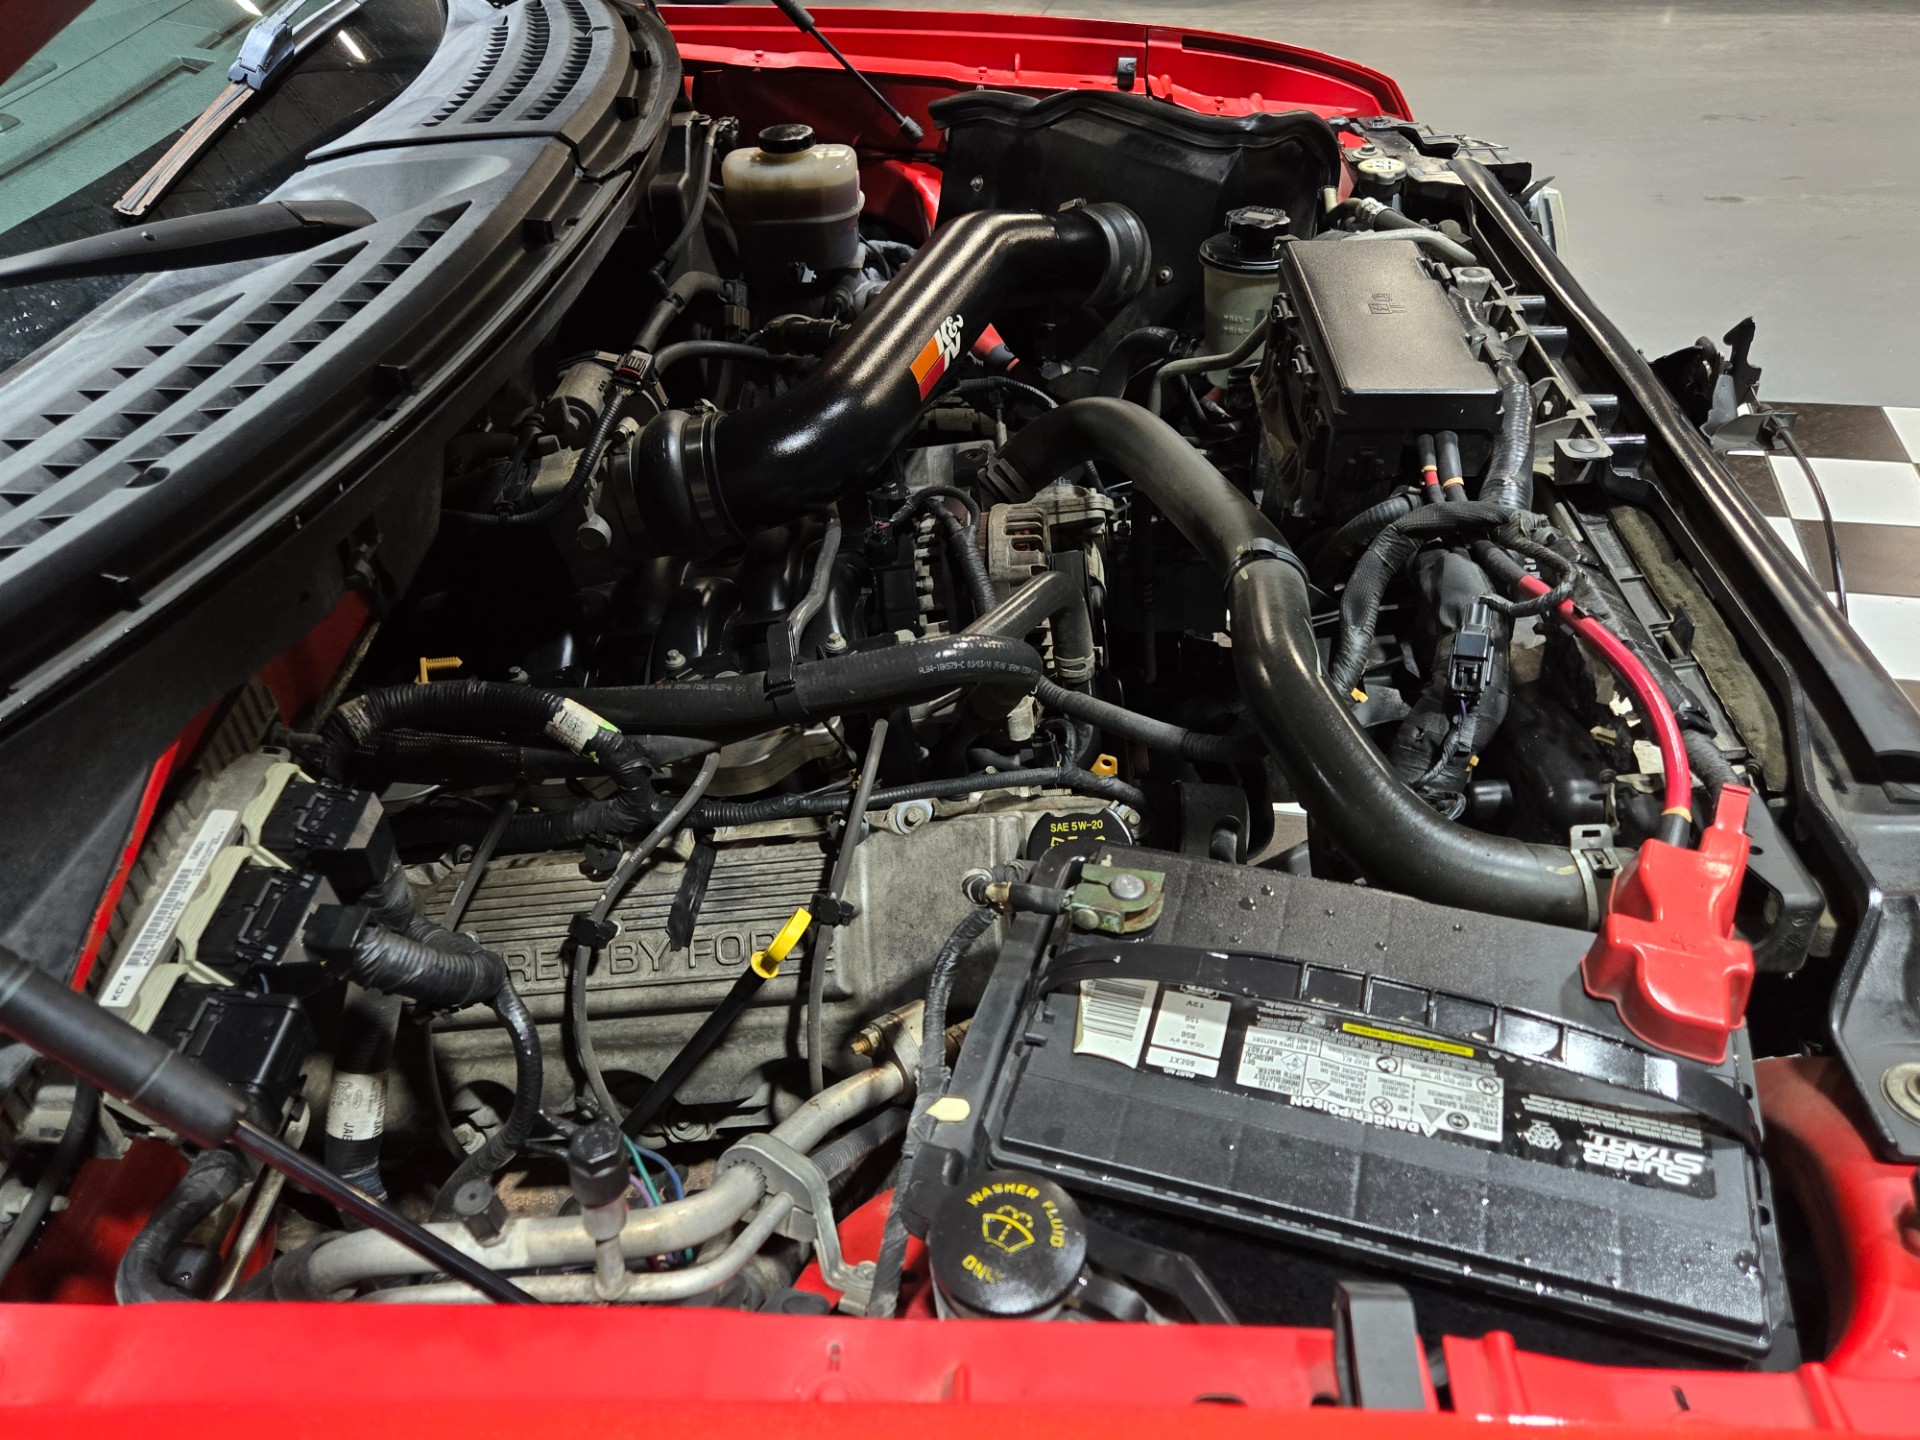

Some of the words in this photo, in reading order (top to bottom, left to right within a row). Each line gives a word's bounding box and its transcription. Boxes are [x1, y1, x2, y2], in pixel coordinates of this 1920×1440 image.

[934, 315, 963, 371] K&N
[1050, 822, 1069, 833] SAE
[1071, 819, 1103, 831] 5W-20
[610, 937, 671, 975] BY
[688, 928, 804, 968] FOR
[111, 975, 132, 1001] KCT4
[1185, 999, 1204, 1009] 12V
[1344, 1087, 1361, 1097] ACID
[1290, 1095, 1421, 1134] DANGER/POISON
[1583, 1136, 1706, 1176] START
[1583, 1149, 1691, 1186] SUPER
[966, 1183, 1040, 1207] WASHER
[1041, 1200, 1065, 1248] FLUID
